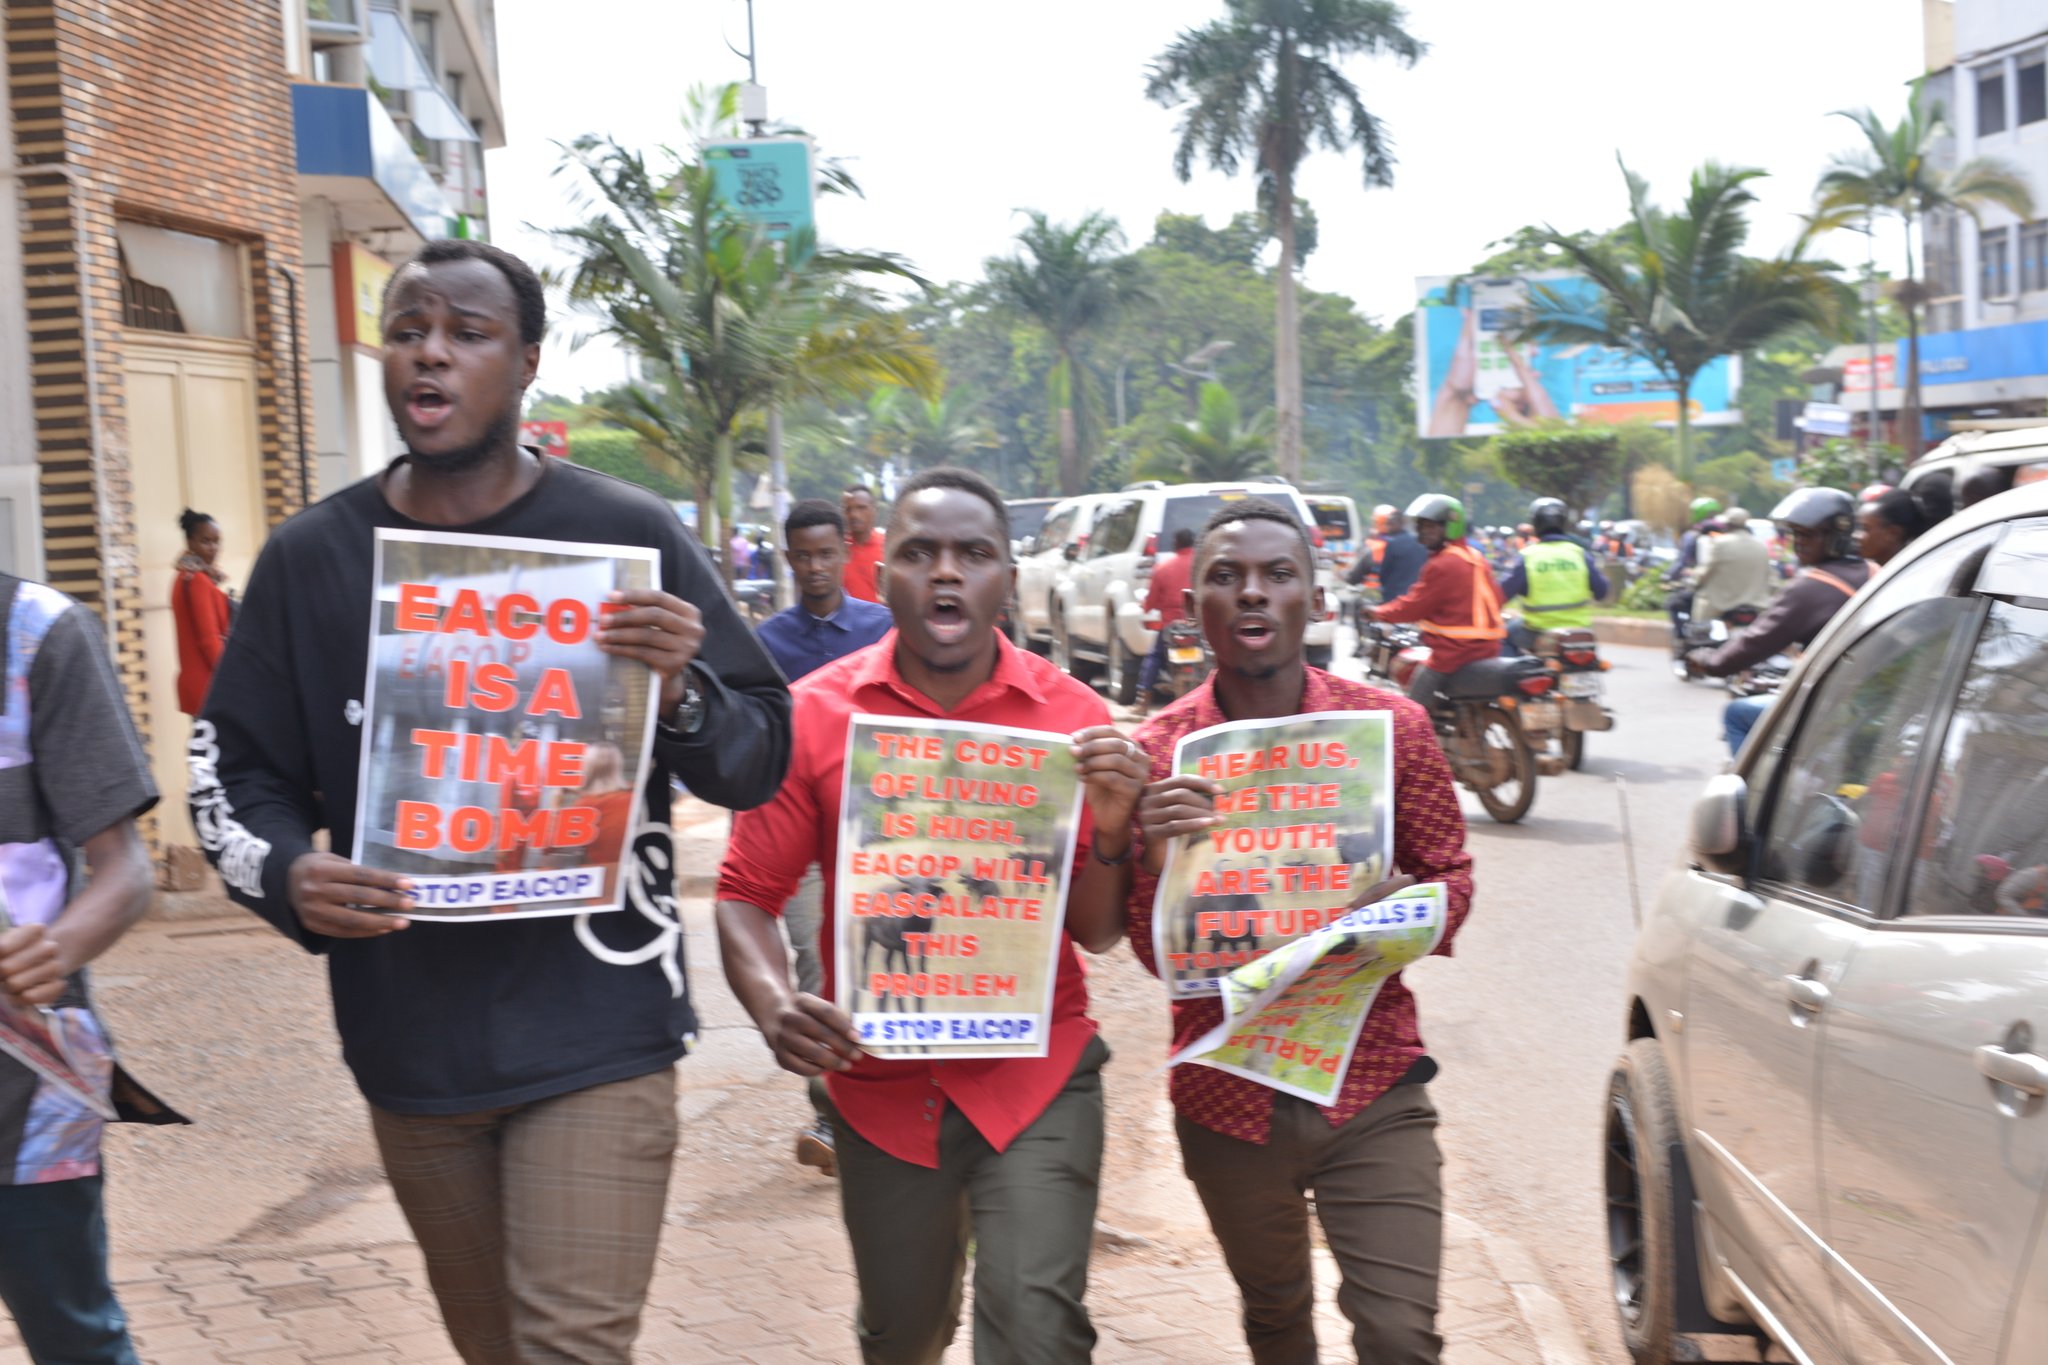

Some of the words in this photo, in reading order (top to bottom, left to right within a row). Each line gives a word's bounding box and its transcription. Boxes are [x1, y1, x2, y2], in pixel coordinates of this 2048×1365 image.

[444, 660, 518, 712] IS
[524, 668, 583, 719] A
[411, 727, 588, 788] TIME
[872, 731, 944, 762] THE
[954, 739, 1050, 772] COST
[1199, 745, 1290, 781] HEAR
[1297, 741, 1360, 770] US,
[871, 772, 918, 799] OF
[922, 776, 1039, 808] LIVING
[1265, 782, 1341, 812] THE
[394, 799, 598, 852] BOMB
[882, 812, 917, 839] IS
[1210, 823, 1337, 855] YOUTH
[850, 852, 962, 879] EACOP
[972, 857, 1049, 885] WILL
[1192, 867, 1270, 898] ARE
[1274, 863, 1351, 893] THE
[492, 874, 592, 901] EACOP
[850, 891, 1042, 922] EASCALATE
[903, 932, 981, 958] THIS
[869, 972, 1018, 999] PROBLEM
[883, 1019, 945, 1041] STOP
[951, 1019, 1034, 1042] EACOP
